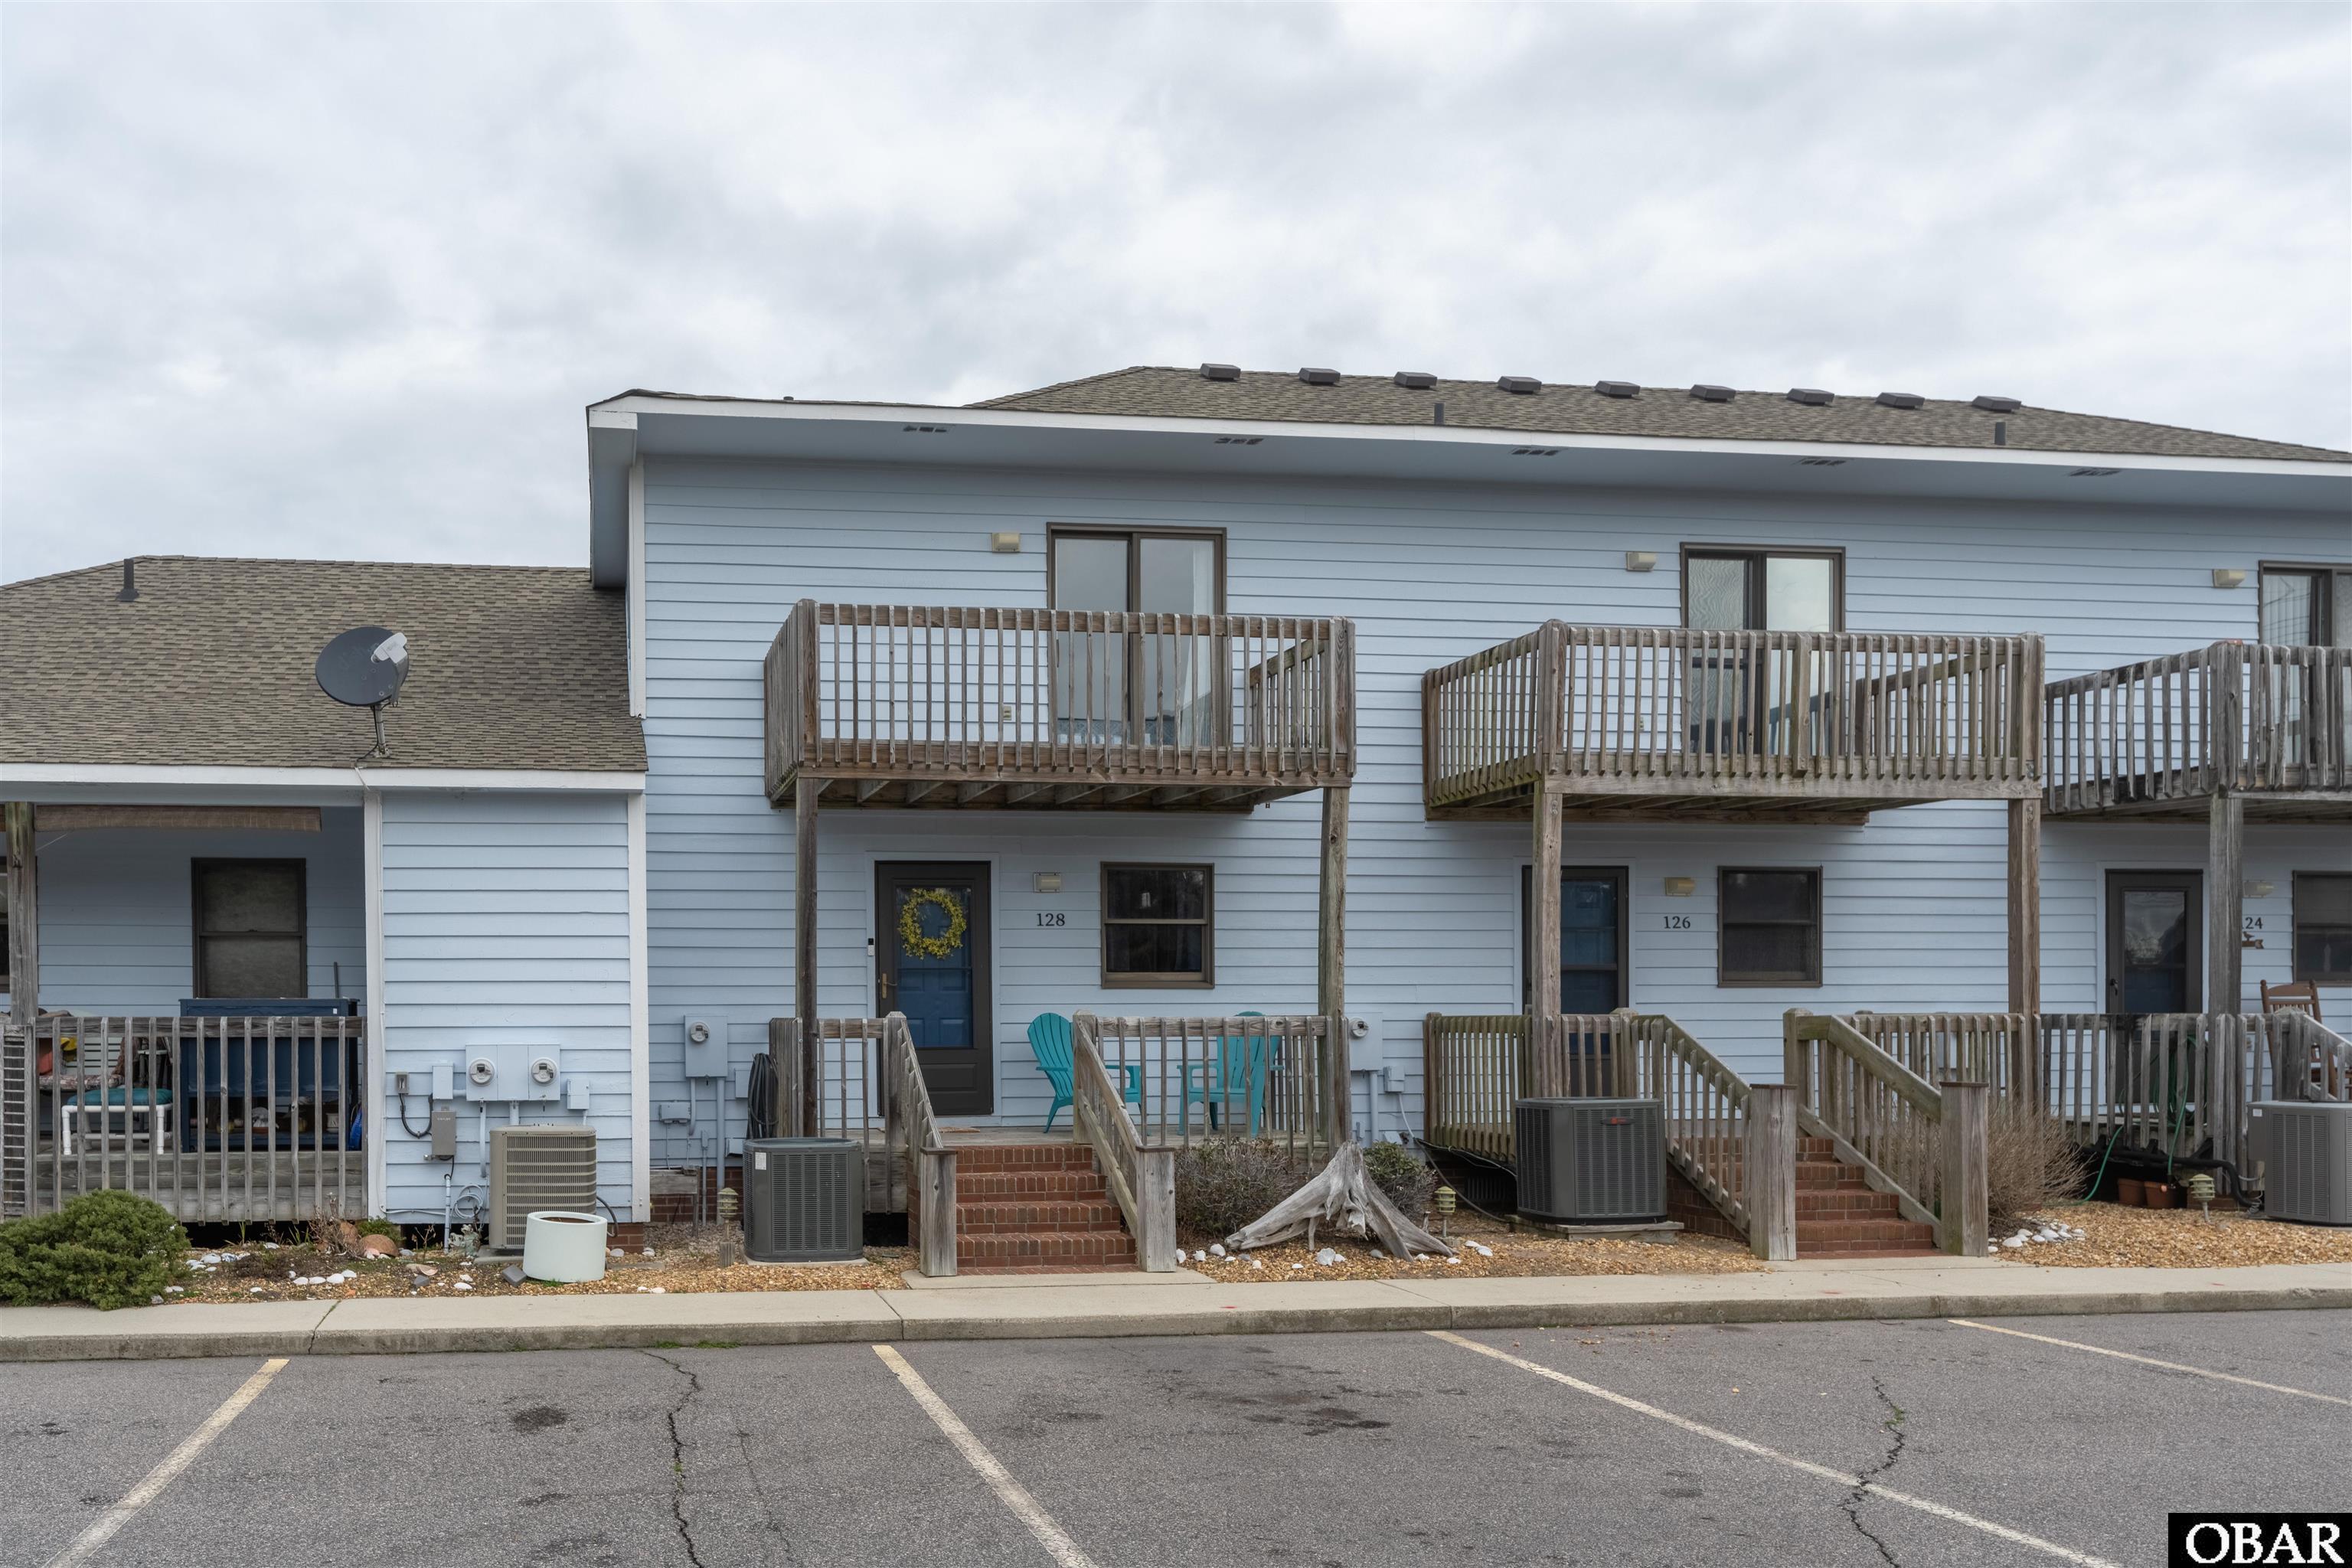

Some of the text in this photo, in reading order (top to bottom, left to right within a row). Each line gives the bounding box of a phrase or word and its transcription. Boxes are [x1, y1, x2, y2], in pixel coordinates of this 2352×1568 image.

[1037, 913, 1065, 926] 128
[1664, 916, 1691, 929] 126
[2241, 916, 2263, 929] 24
